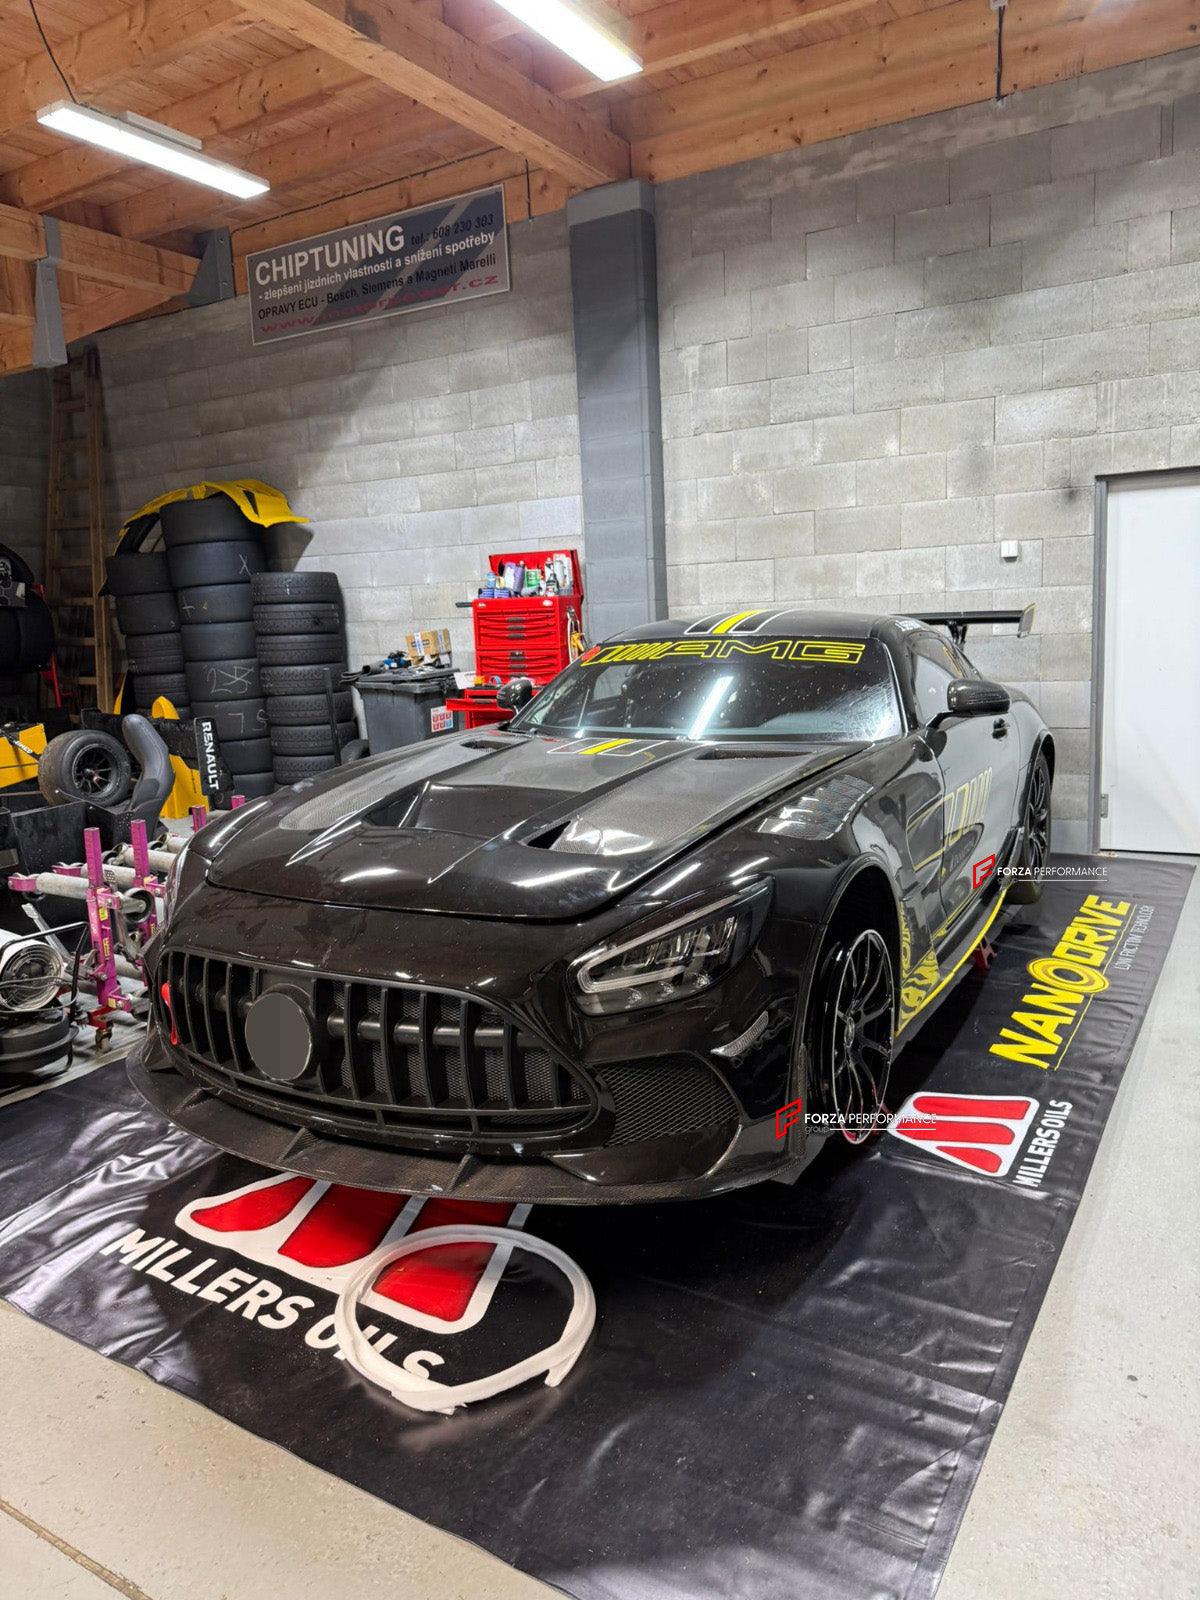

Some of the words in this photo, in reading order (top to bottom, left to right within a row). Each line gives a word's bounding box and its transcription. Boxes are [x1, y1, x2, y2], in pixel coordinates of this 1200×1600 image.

[255, 224, 405, 286] CHIPTUNING
[432, 225, 451, 239] 608
[453, 219, 472, 234] 230
[474, 213, 494, 229] 303
[395, 259, 402, 267] a
[445, 231, 495, 256] spotřeby
[258, 300, 296, 320] OPRAVY
[299, 296, 318, 311] ECU
[361, 277, 404, 295] Siemens
[414, 265, 457, 284] Magneti
[459, 253, 496, 273] Marelli
[201, 721, 220, 791] RENAULT
[989, 895, 1131, 1069] NANODRIVE
[1013, 1127, 1060, 1187] MILLERS
[1041, 1100, 1073, 1128] OILS
[99, 1228, 315, 1329] MILLERS
